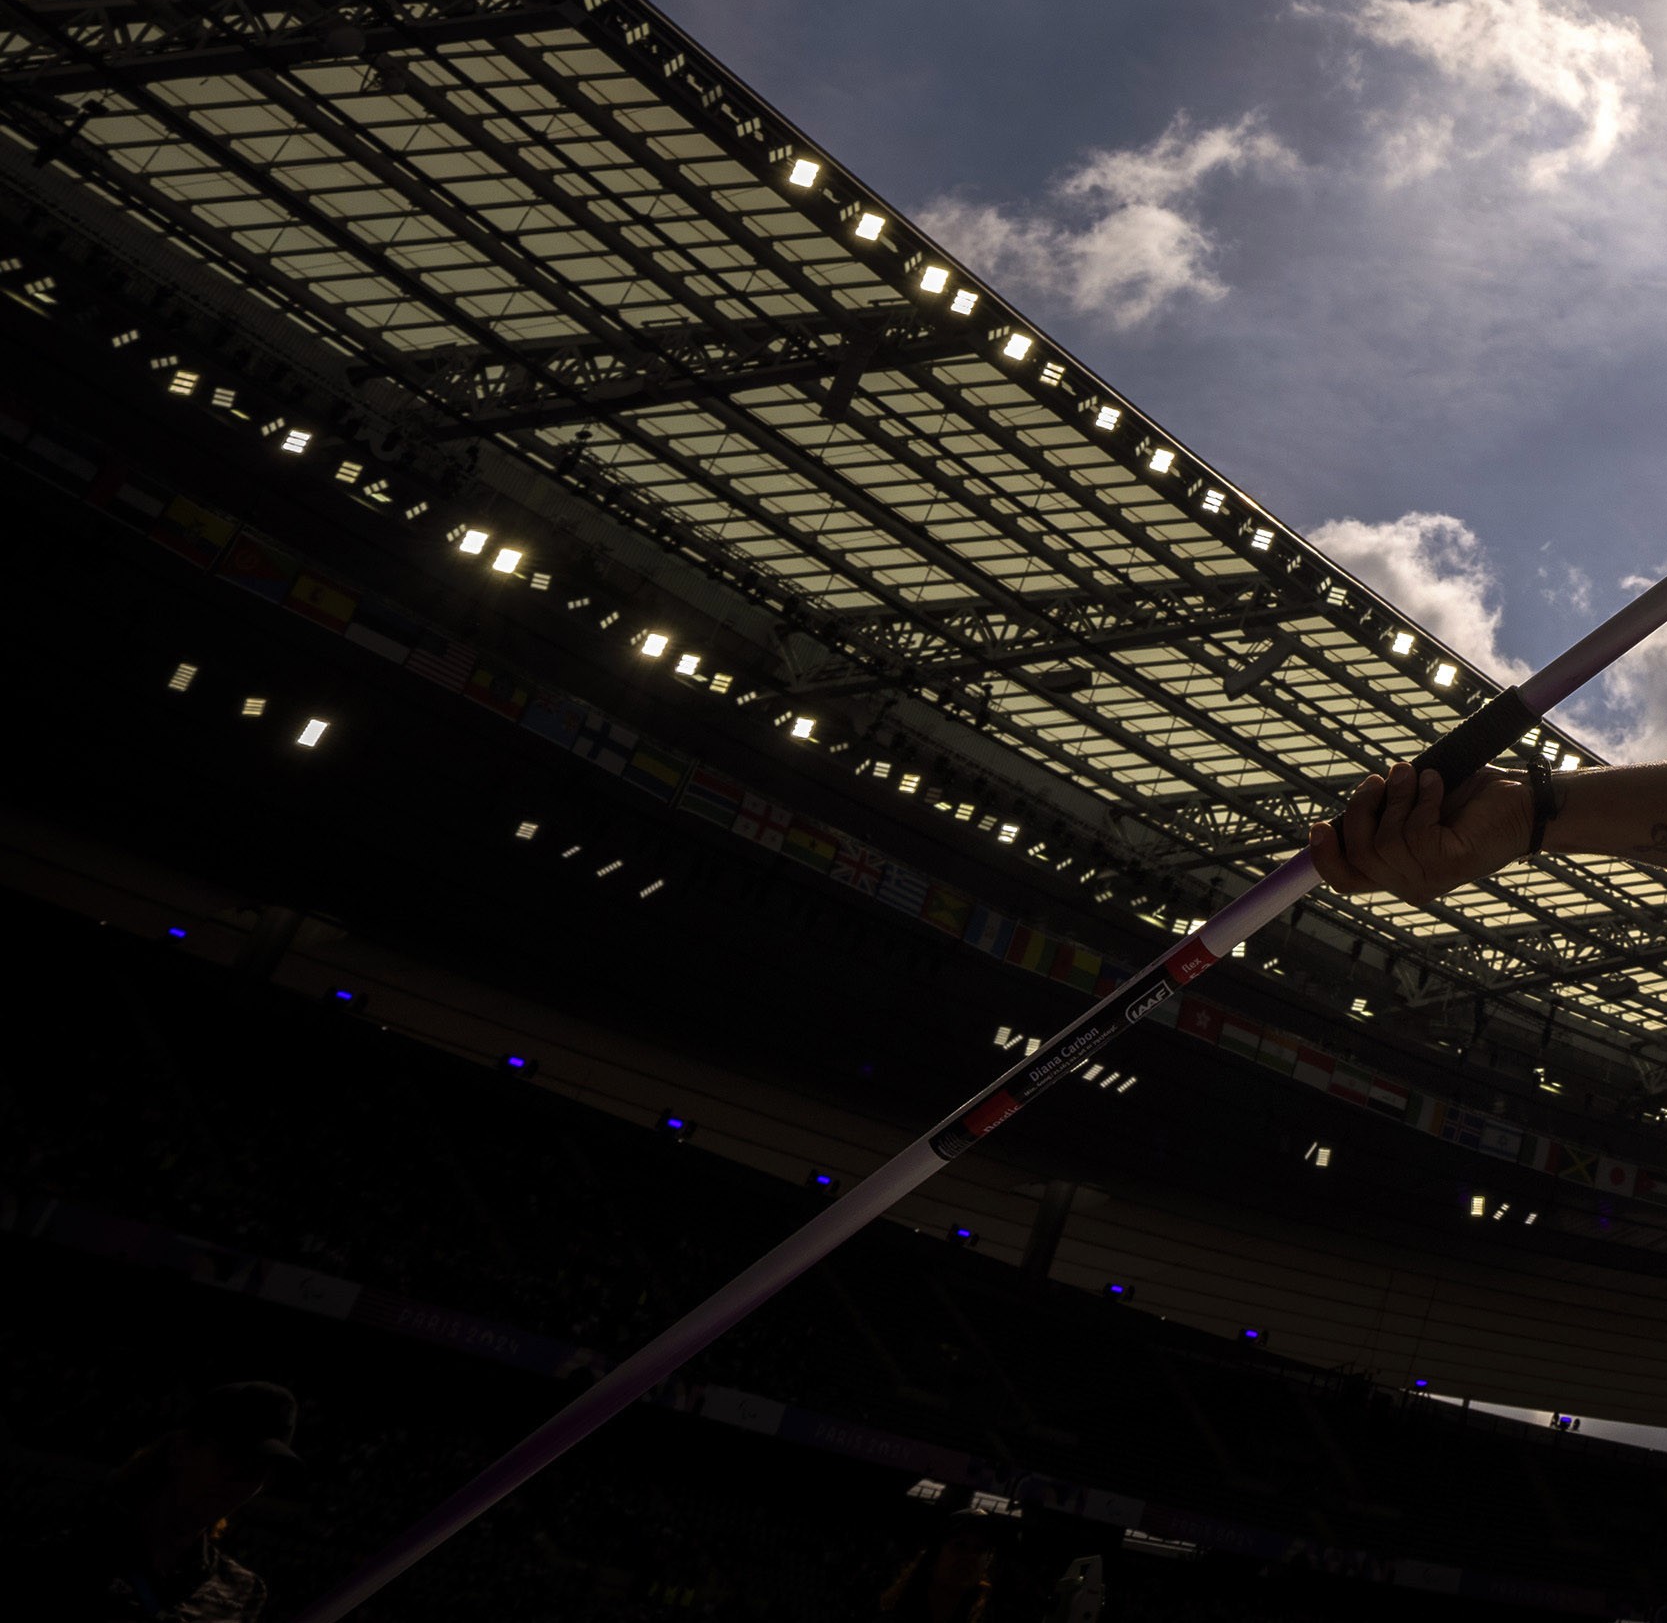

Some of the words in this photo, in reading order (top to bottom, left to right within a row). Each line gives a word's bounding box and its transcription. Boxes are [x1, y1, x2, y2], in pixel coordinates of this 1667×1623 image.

[1181, 958, 1203, 974] flex
[1131, 987, 1167, 1019] IAAF
[1029, 1056, 1062, 1082] Diana
[1060, 1027, 1100, 1058] Carbon
[398, 1308, 461, 1339] PARIS
[465, 1327, 520, 1355] 2024
[815, 1423, 863, 1450] PARIS
[867, 1438, 912, 1461] 2024
